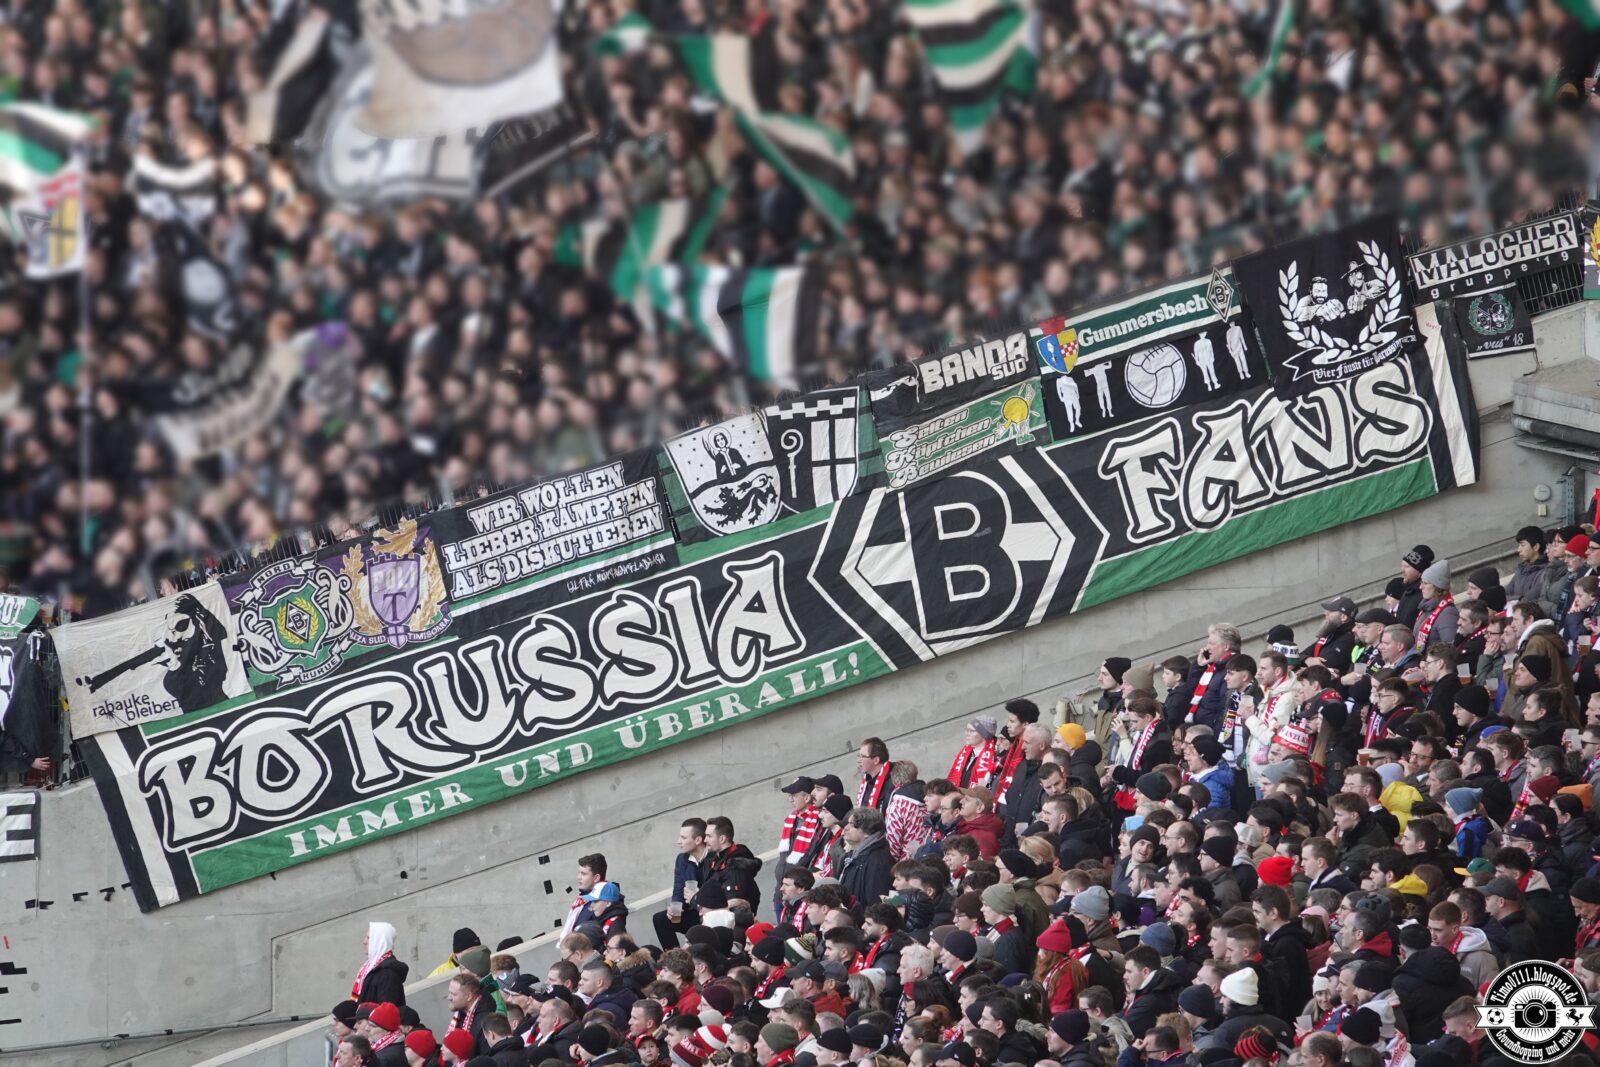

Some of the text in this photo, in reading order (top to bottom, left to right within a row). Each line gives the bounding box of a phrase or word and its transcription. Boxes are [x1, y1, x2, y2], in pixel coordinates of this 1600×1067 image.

[1412, 218, 1575, 287] MALOCHER
[1077, 294, 1209, 347] Gummersbach
[1513, 332, 1524, 346] 18
[918, 332, 1029, 394] BANDA
[1314, 368, 1335, 380] Vier
[442, 478, 658, 571] LIEBER KÄMPFEN
[468, 461, 625, 534] WIR WOLLEN
[257, 562, 292, 584] NORD
[451, 504, 664, 600] ALS DISKUTIEREN
[138, 550, 807, 853] BORUSSIA
[1098, 357, 1434, 544] FANS
[383, 592, 407, 621] T
[92, 692, 151, 718] rabauke
[126, 696, 181, 721] bleiben
[285, 651, 862, 858] IMMER UND ÜBERALL!
